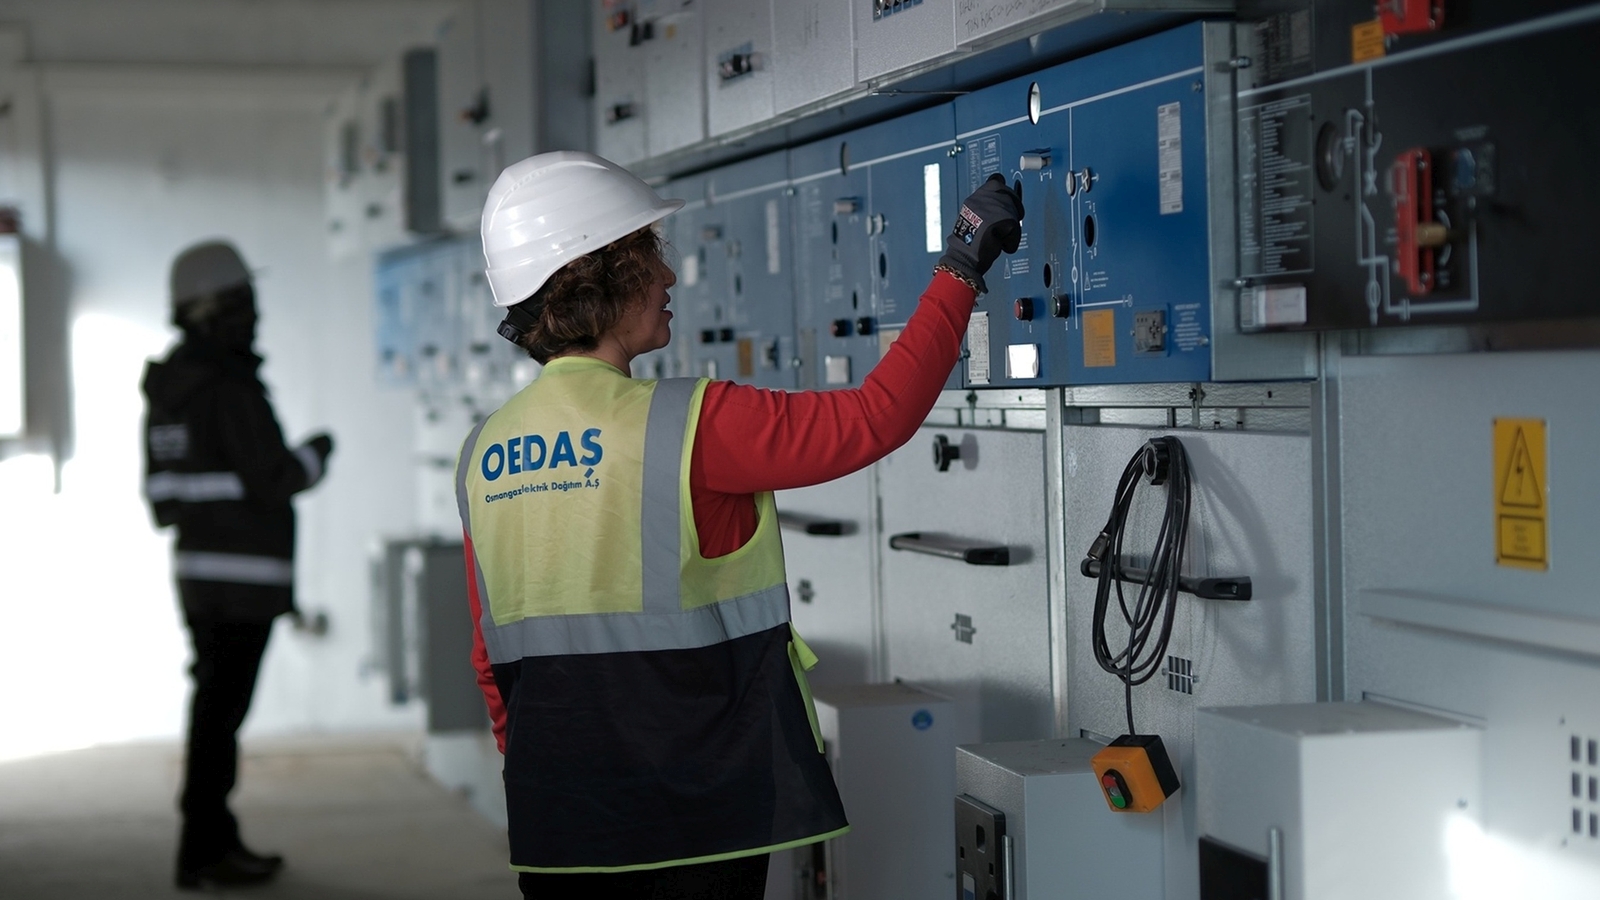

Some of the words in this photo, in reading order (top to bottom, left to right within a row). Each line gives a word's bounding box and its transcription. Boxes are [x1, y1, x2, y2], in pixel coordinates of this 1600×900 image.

[482, 428, 603, 481] OEDAŞ
[485, 488, 522, 503] Osmangaz
[551, 481, 582, 491] Dağıtım
